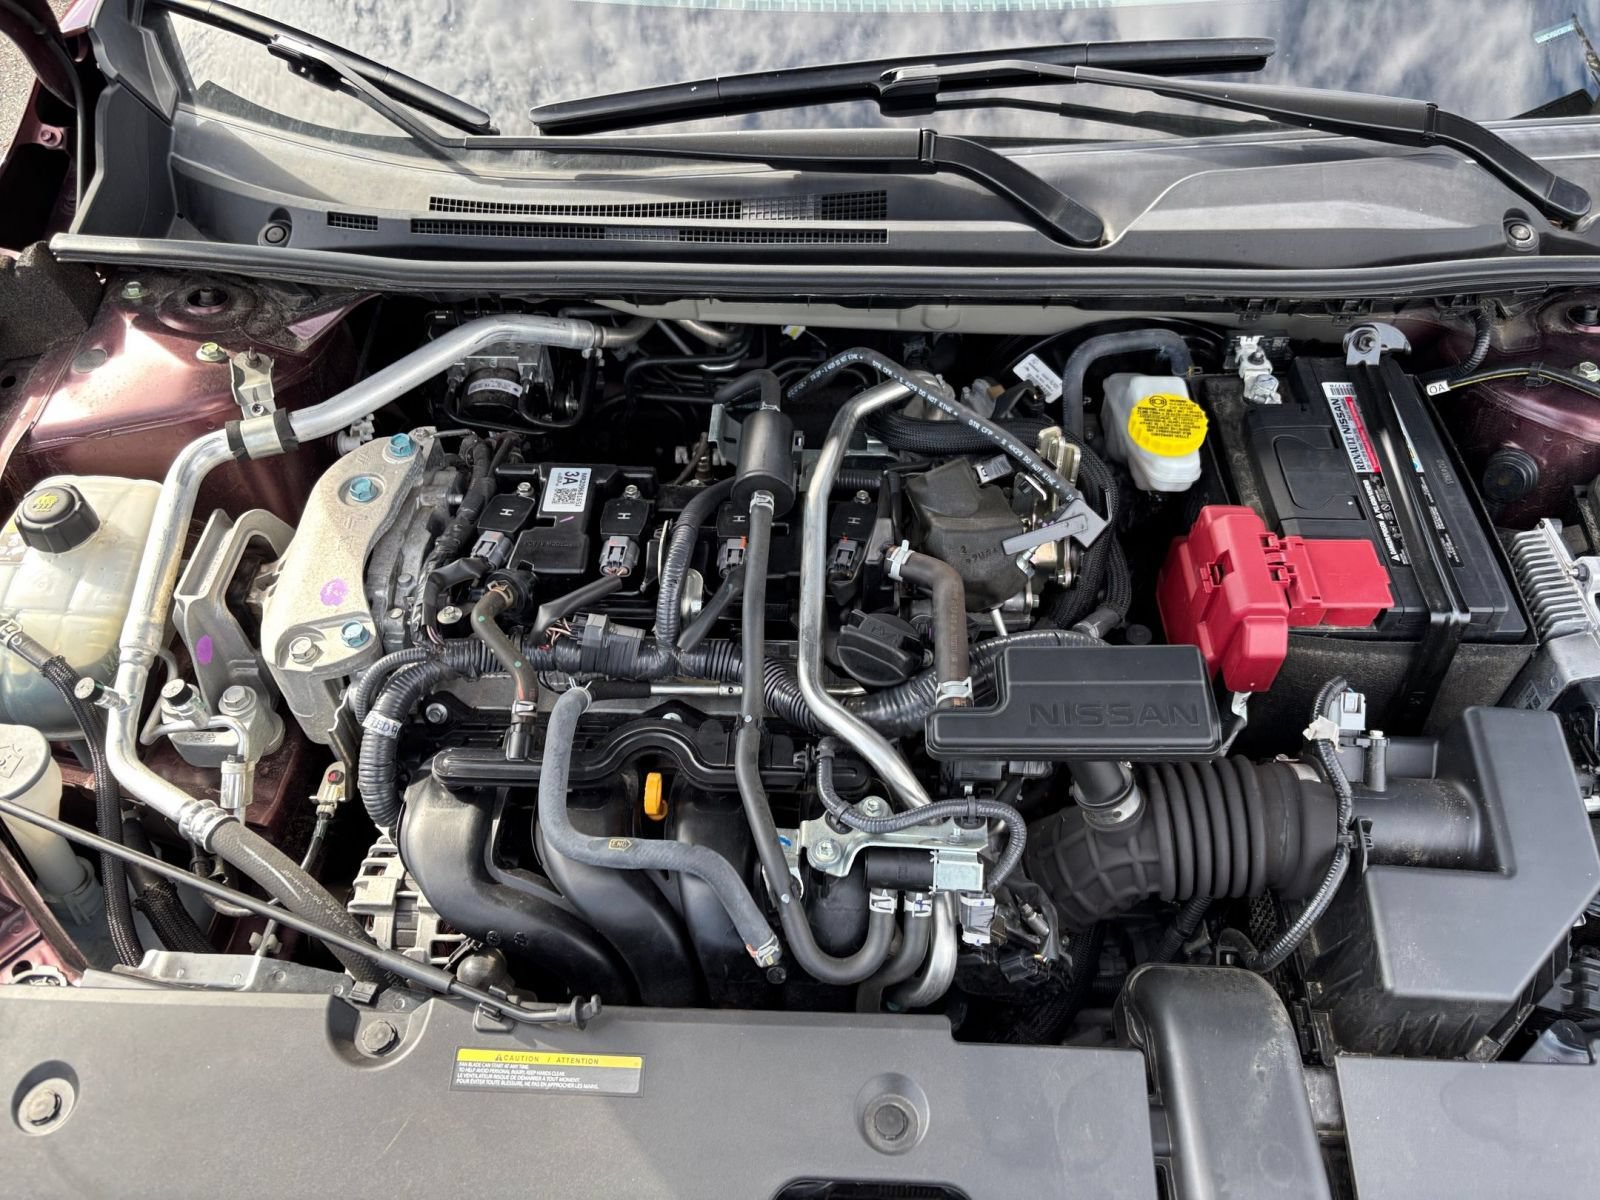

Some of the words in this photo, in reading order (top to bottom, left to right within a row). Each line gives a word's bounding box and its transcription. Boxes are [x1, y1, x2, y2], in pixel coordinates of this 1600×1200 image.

[1330, 398, 1352, 435] NISSAN
[1345, 436, 1367, 471] RENAULT
[563, 471, 580, 485] 3A
[1029, 702, 1199, 728] NISSAN
[503, 1054, 539, 1062] CAUTION
[556, 1056, 599, 1065] ATTENTION
